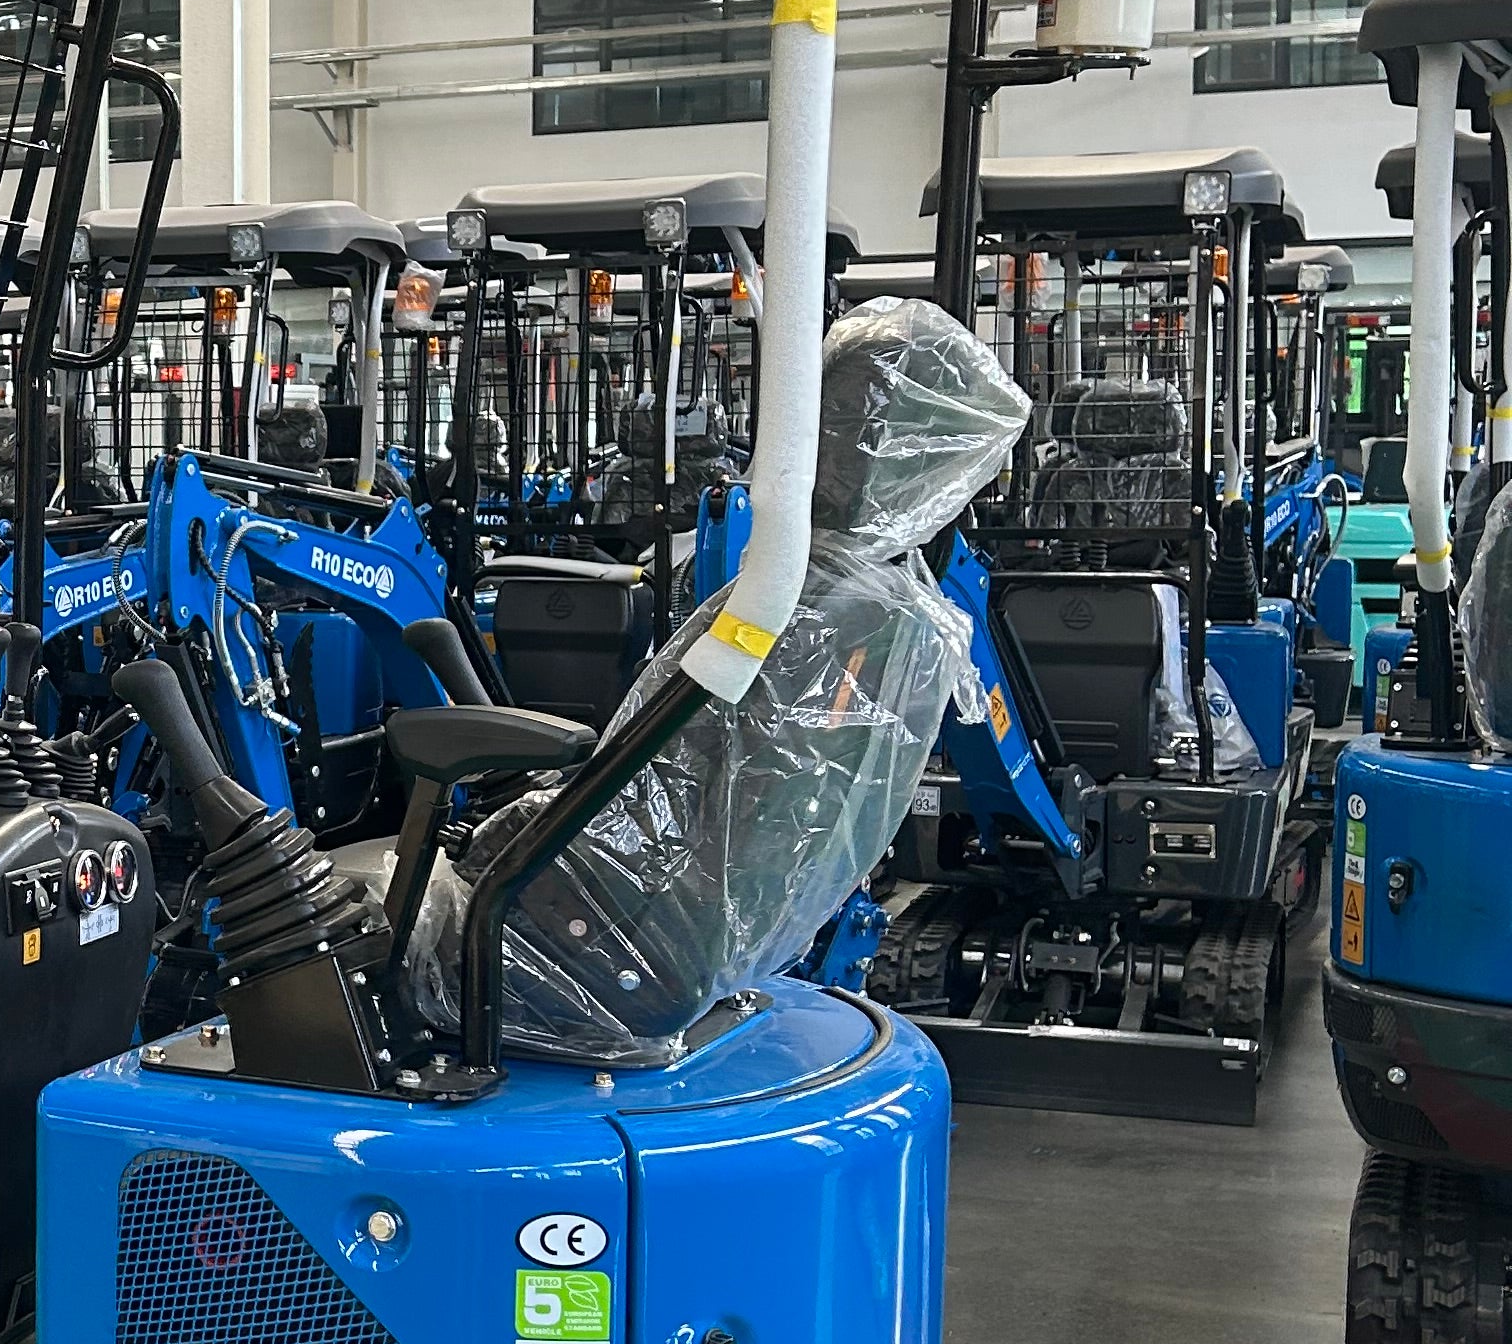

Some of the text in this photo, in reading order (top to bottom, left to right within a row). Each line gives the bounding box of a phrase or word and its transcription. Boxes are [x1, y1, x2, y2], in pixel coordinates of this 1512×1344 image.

[310, 546, 376, 590] R10 ECO
[73, 581, 101, 609] R10
[915, 798, 929, 811] 93
[540, 1223, 586, 1256] CE
[528, 1278, 560, 1287] EURO
[524, 1277, 562, 1326] 5
